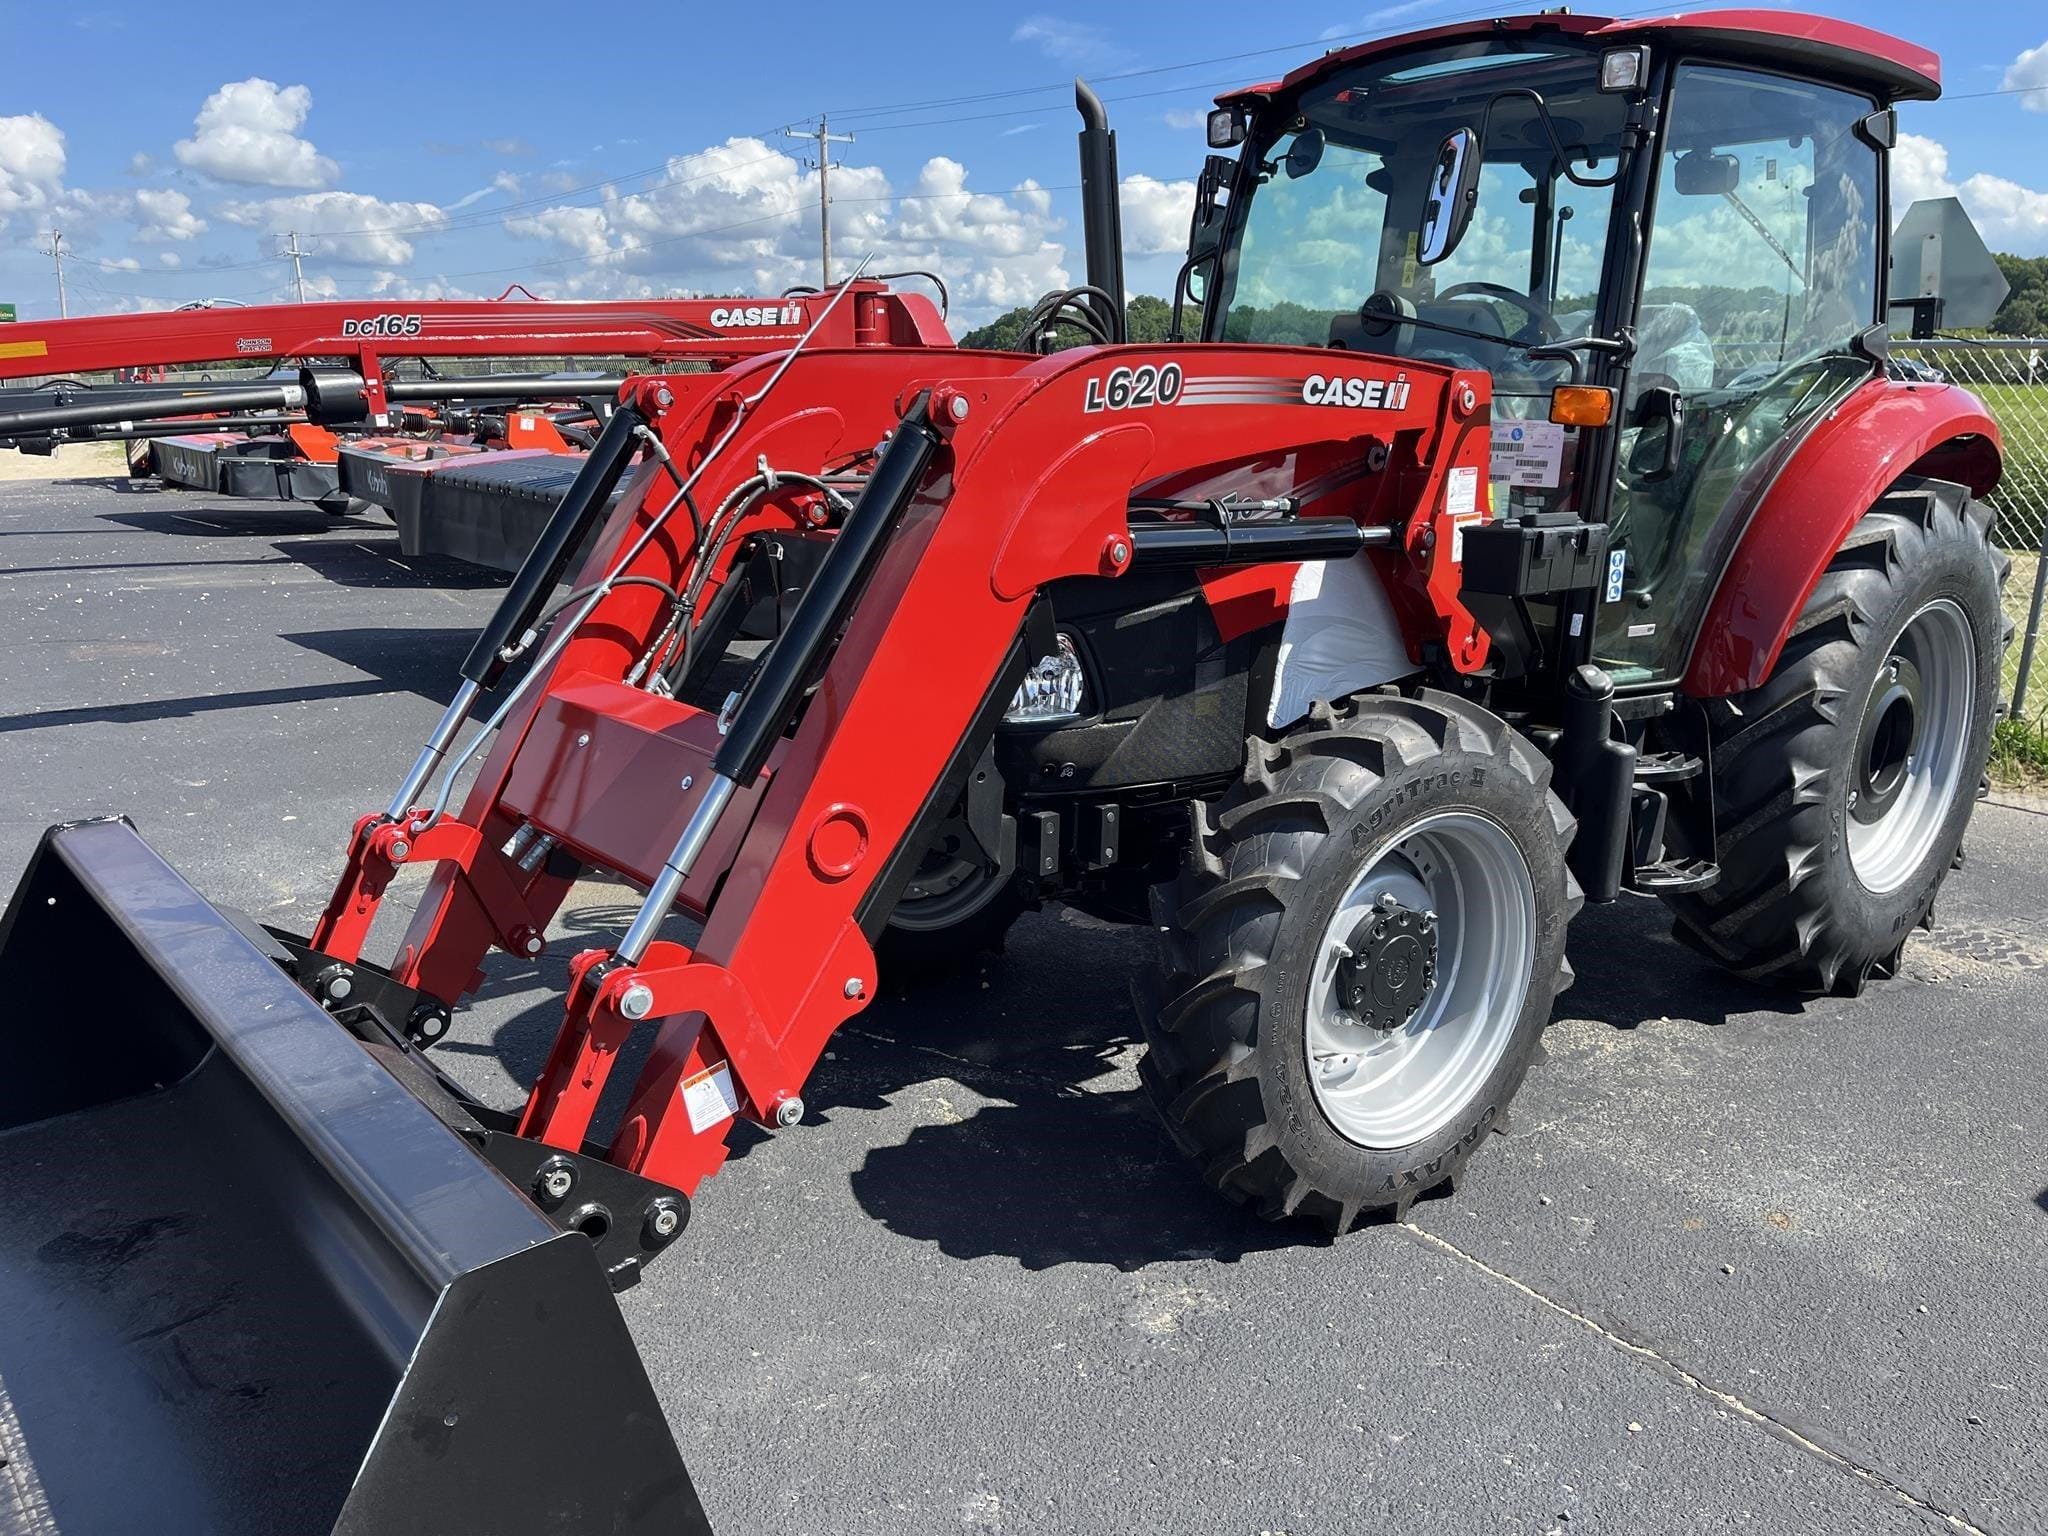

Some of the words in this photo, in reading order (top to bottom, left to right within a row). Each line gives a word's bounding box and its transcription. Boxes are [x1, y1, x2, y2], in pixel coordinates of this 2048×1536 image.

[343, 315, 422, 337] DC165
[710, 307, 778, 328] CASE
[1084, 362, 1183, 413] L620
[1302, 374, 1384, 408] CASE
[1350, 771, 1462, 848] AgriTrac
[1375, 1104, 1497, 1194] GALAXY
